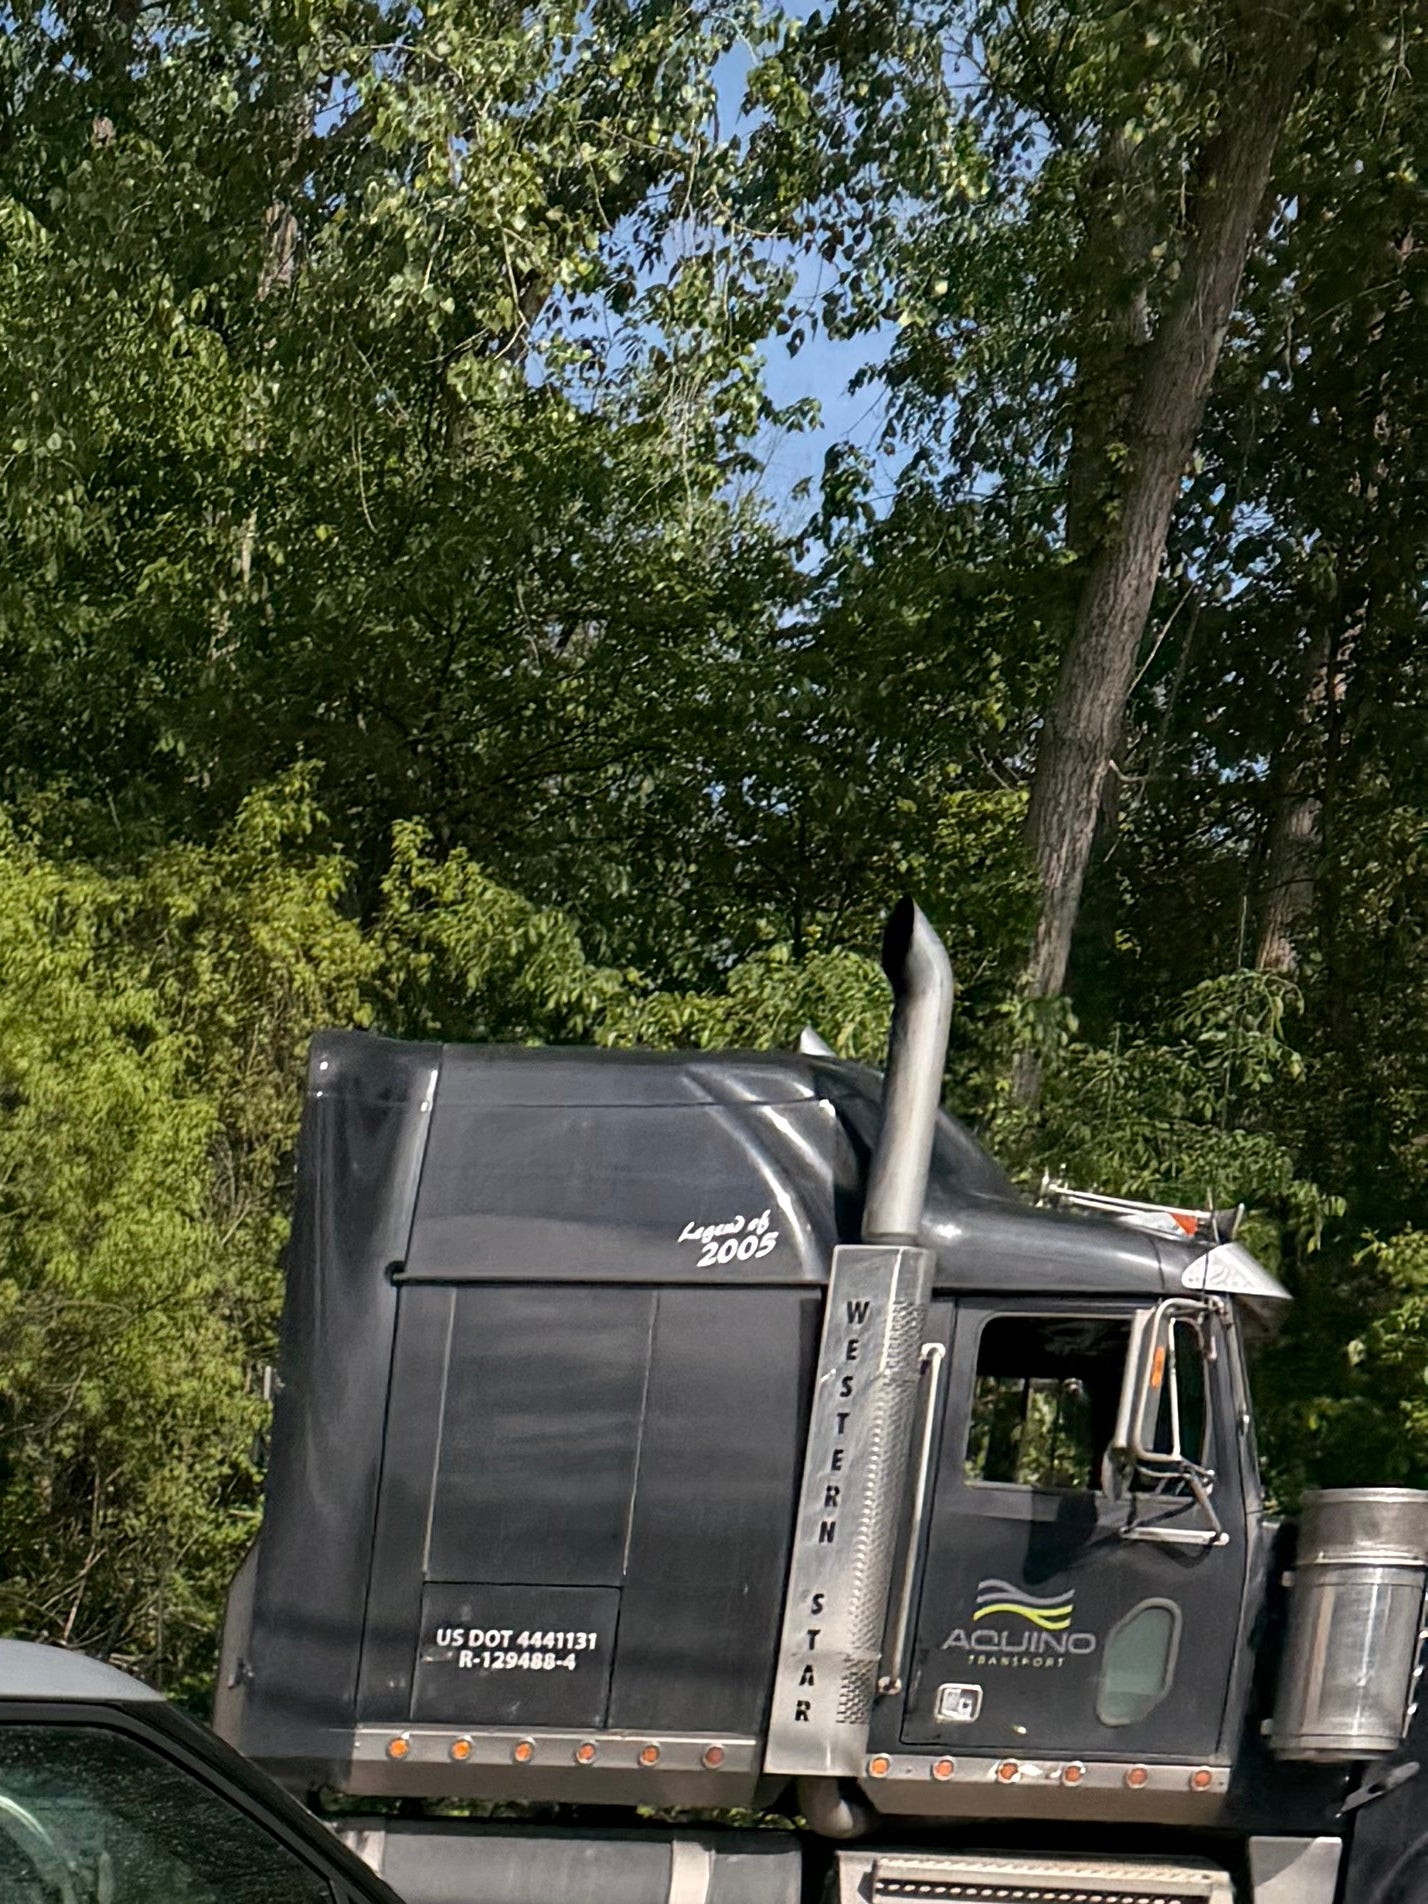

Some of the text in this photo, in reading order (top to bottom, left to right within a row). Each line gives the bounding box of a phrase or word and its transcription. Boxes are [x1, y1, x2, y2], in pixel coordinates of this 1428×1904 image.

[677, 1209, 771, 1244] Legend of
[696, 1231, 779, 1268] 2005
[794, 1300, 871, 1722] WESTERN STAR
[436, 1628, 598, 1651] US DOT 4441131
[941, 1628, 1097, 1655] AQUINO
[458, 1650, 577, 1671] R-129488-4
[967, 1654, 1066, 1669] TRANSPORT
